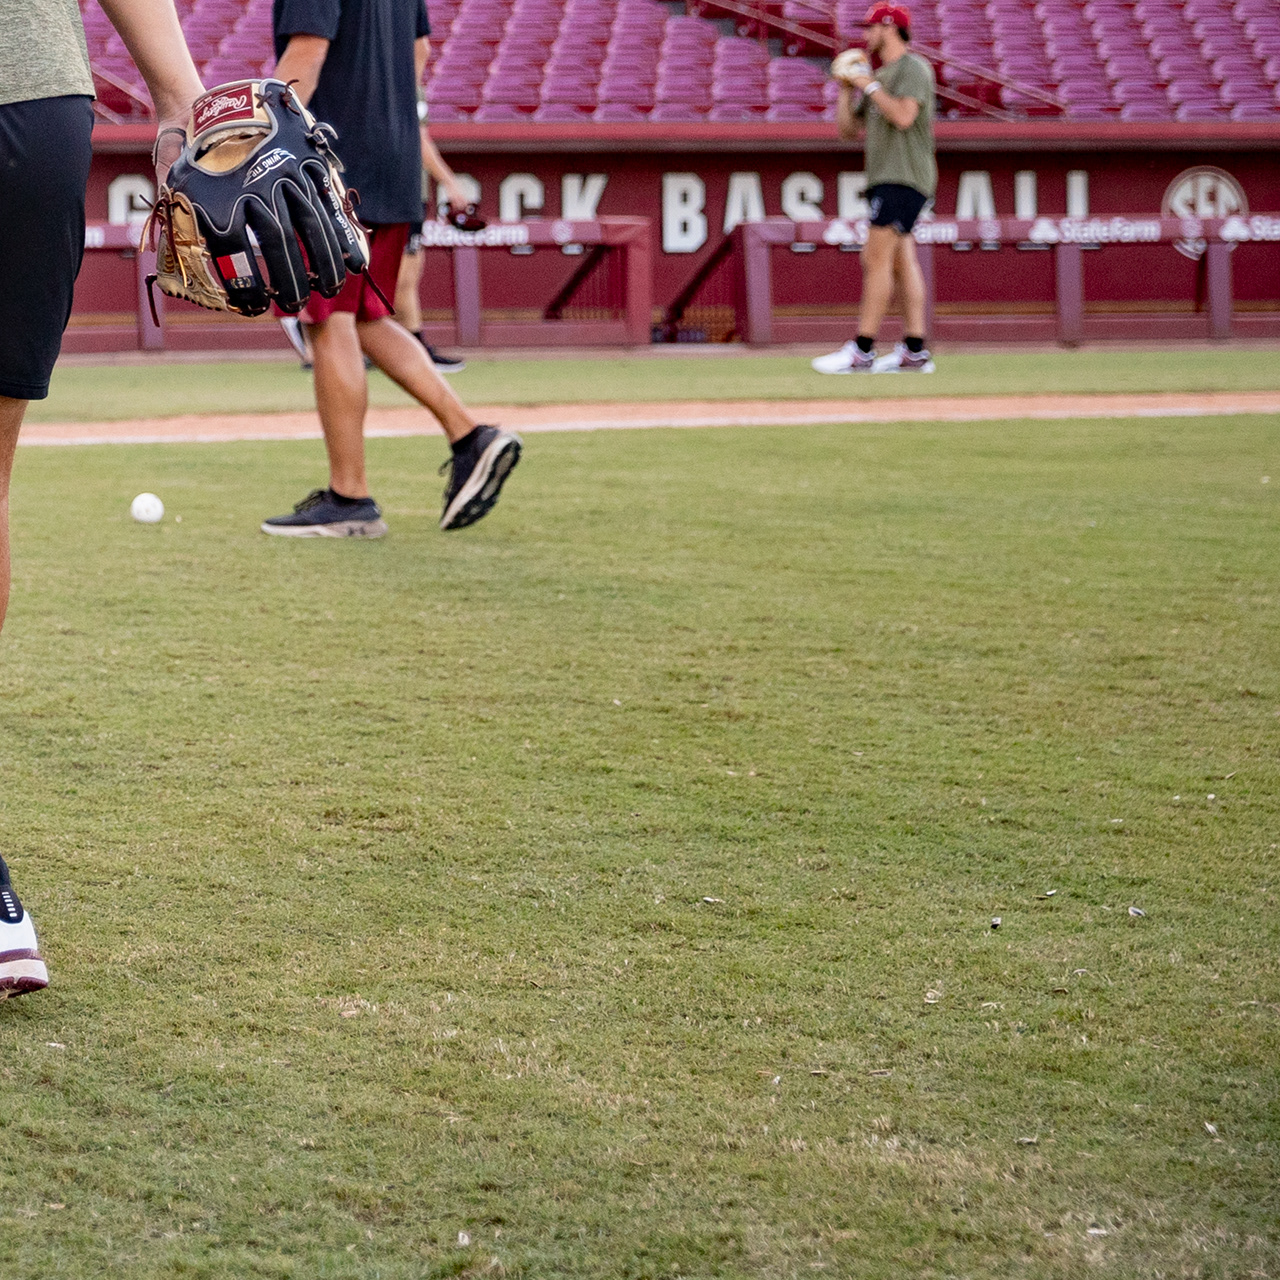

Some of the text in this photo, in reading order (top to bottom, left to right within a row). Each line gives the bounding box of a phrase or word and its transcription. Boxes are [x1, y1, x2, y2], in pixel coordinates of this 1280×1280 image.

[197, 95, 247, 124] Rawlings
[263, 153, 281, 169] WING
[661, 171, 1088, 254] BASEALL
